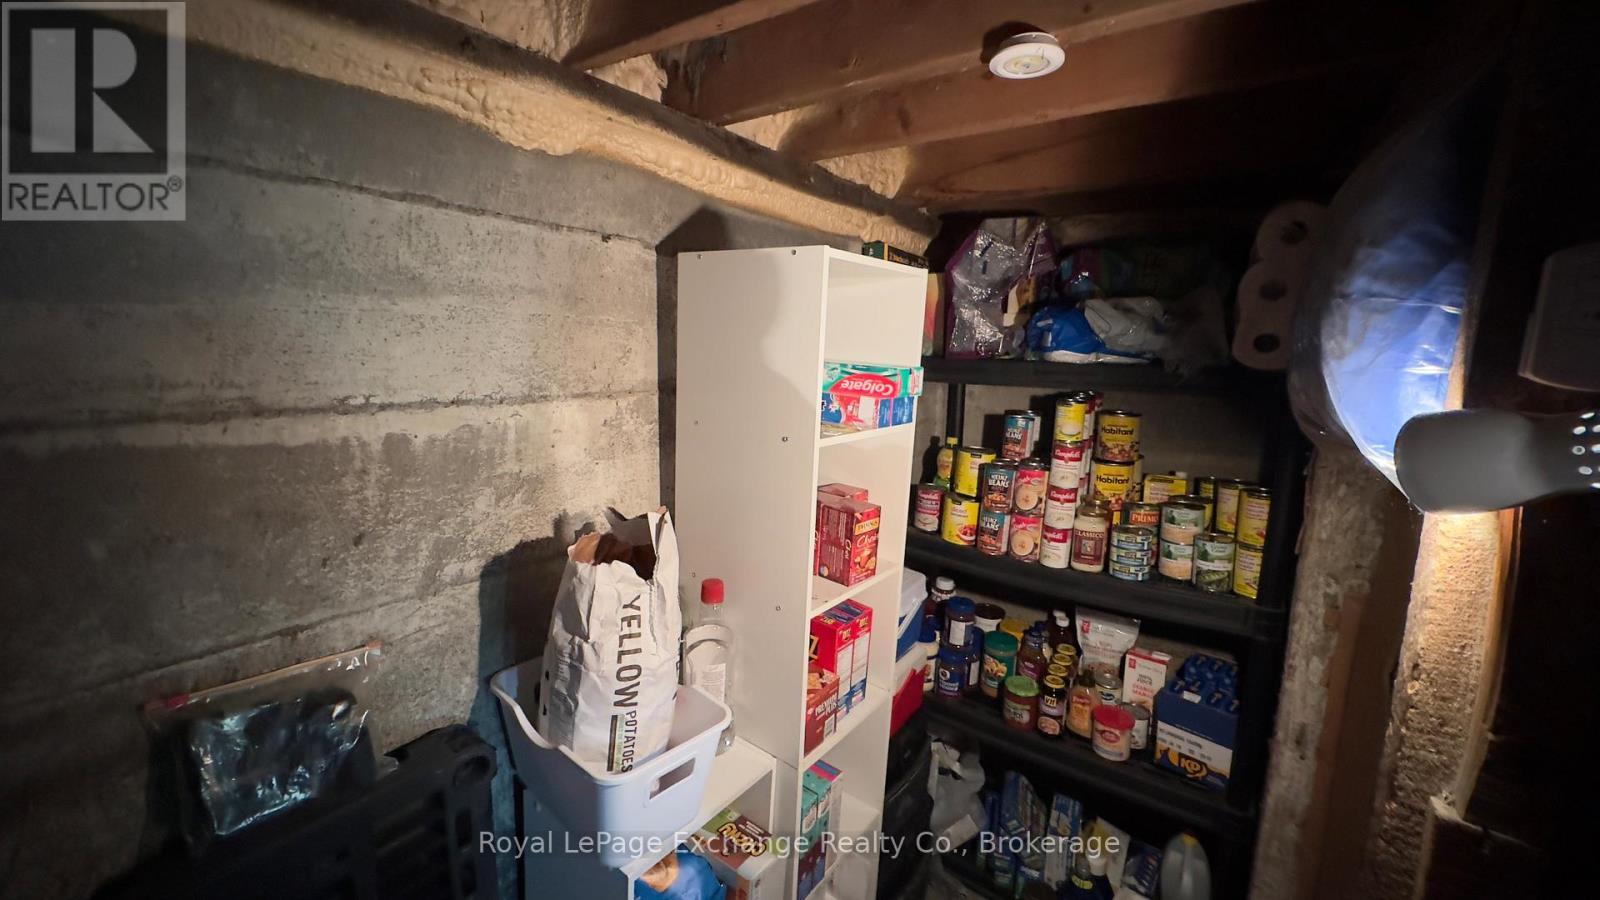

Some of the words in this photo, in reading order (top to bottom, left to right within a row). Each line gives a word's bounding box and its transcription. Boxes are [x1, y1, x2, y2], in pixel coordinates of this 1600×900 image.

[840, 379, 894, 396] Colgate
[1101, 426, 1134, 437] Habitant
[988, 478, 1010, 488] BEANS
[1096, 474, 1130, 485] Habitant
[613, 594, 642, 708] YELLOW
[621, 709, 637, 773] POTATOES
